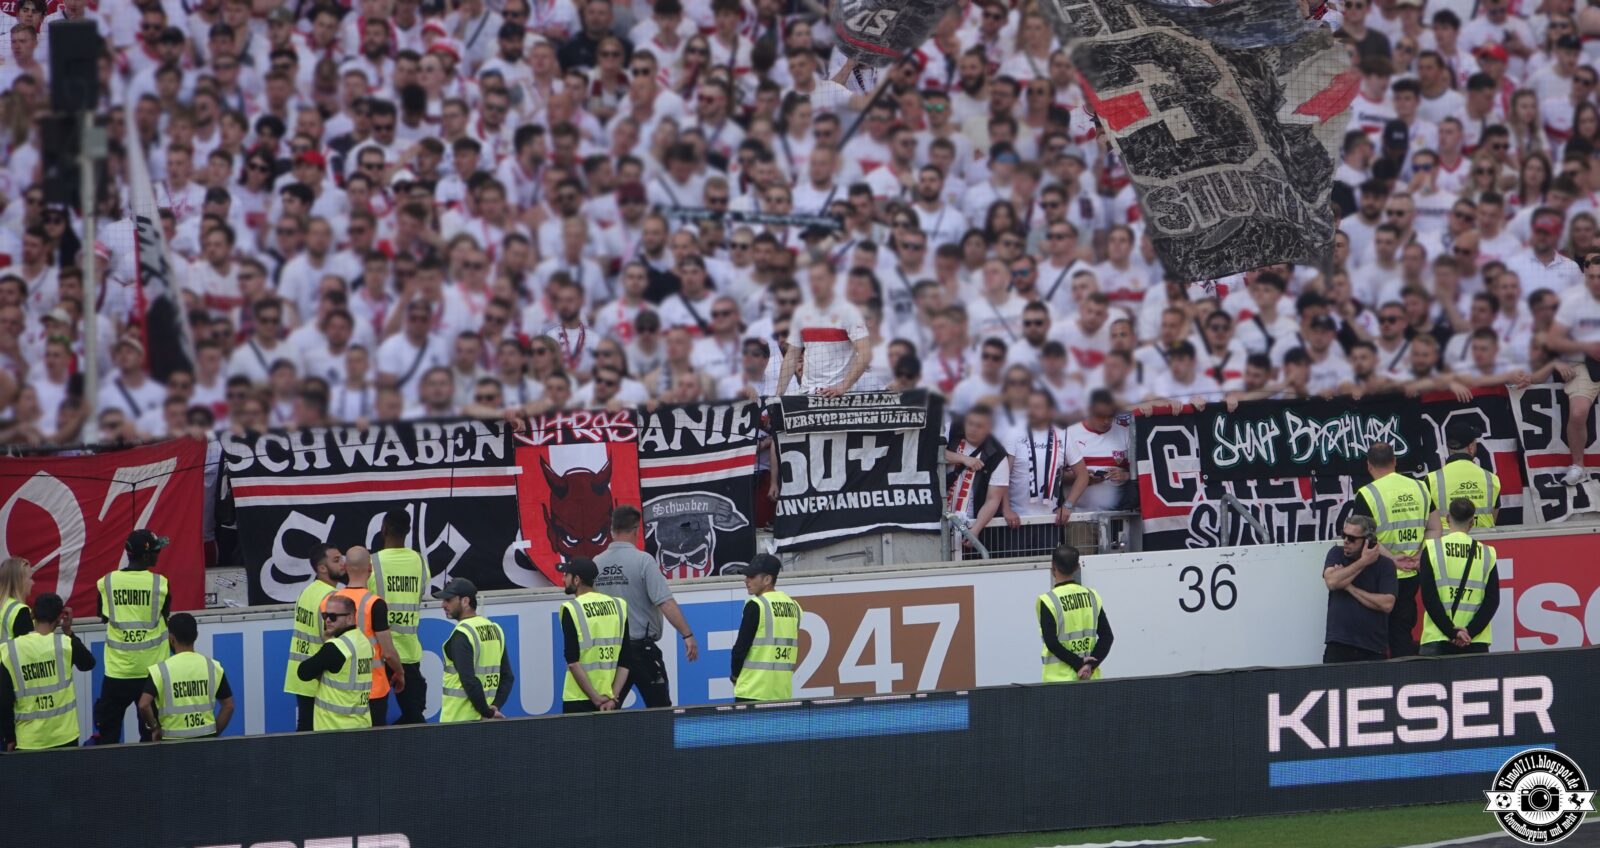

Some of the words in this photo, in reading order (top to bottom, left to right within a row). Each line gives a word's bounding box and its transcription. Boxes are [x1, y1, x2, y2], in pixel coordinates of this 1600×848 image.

[880, 411, 926, 424] ULTRAS
[220, 420, 504, 472] SCHWABEN
[777, 430, 931, 496] 50+1
[652, 499, 709, 517] Schwaben
[1398, 529, 1417, 542] 0484
[1445, 542, 1482, 560] SECURTY
[387, 575, 419, 593] SECURITY
[1179, 563, 1238, 613] 36
[113, 589, 151, 606] SECURITY
[1060, 592, 1092, 612] SECURITY
[583, 600, 618, 618] SECURITY
[389, 612, 415, 625] 3241
[123, 630, 147, 643] 2657
[792, 603, 960, 698] 247
[21, 660, 56, 681] SECURITY
[173, 680, 208, 699] SECURITY
[1267, 675, 1555, 752] KIESER
